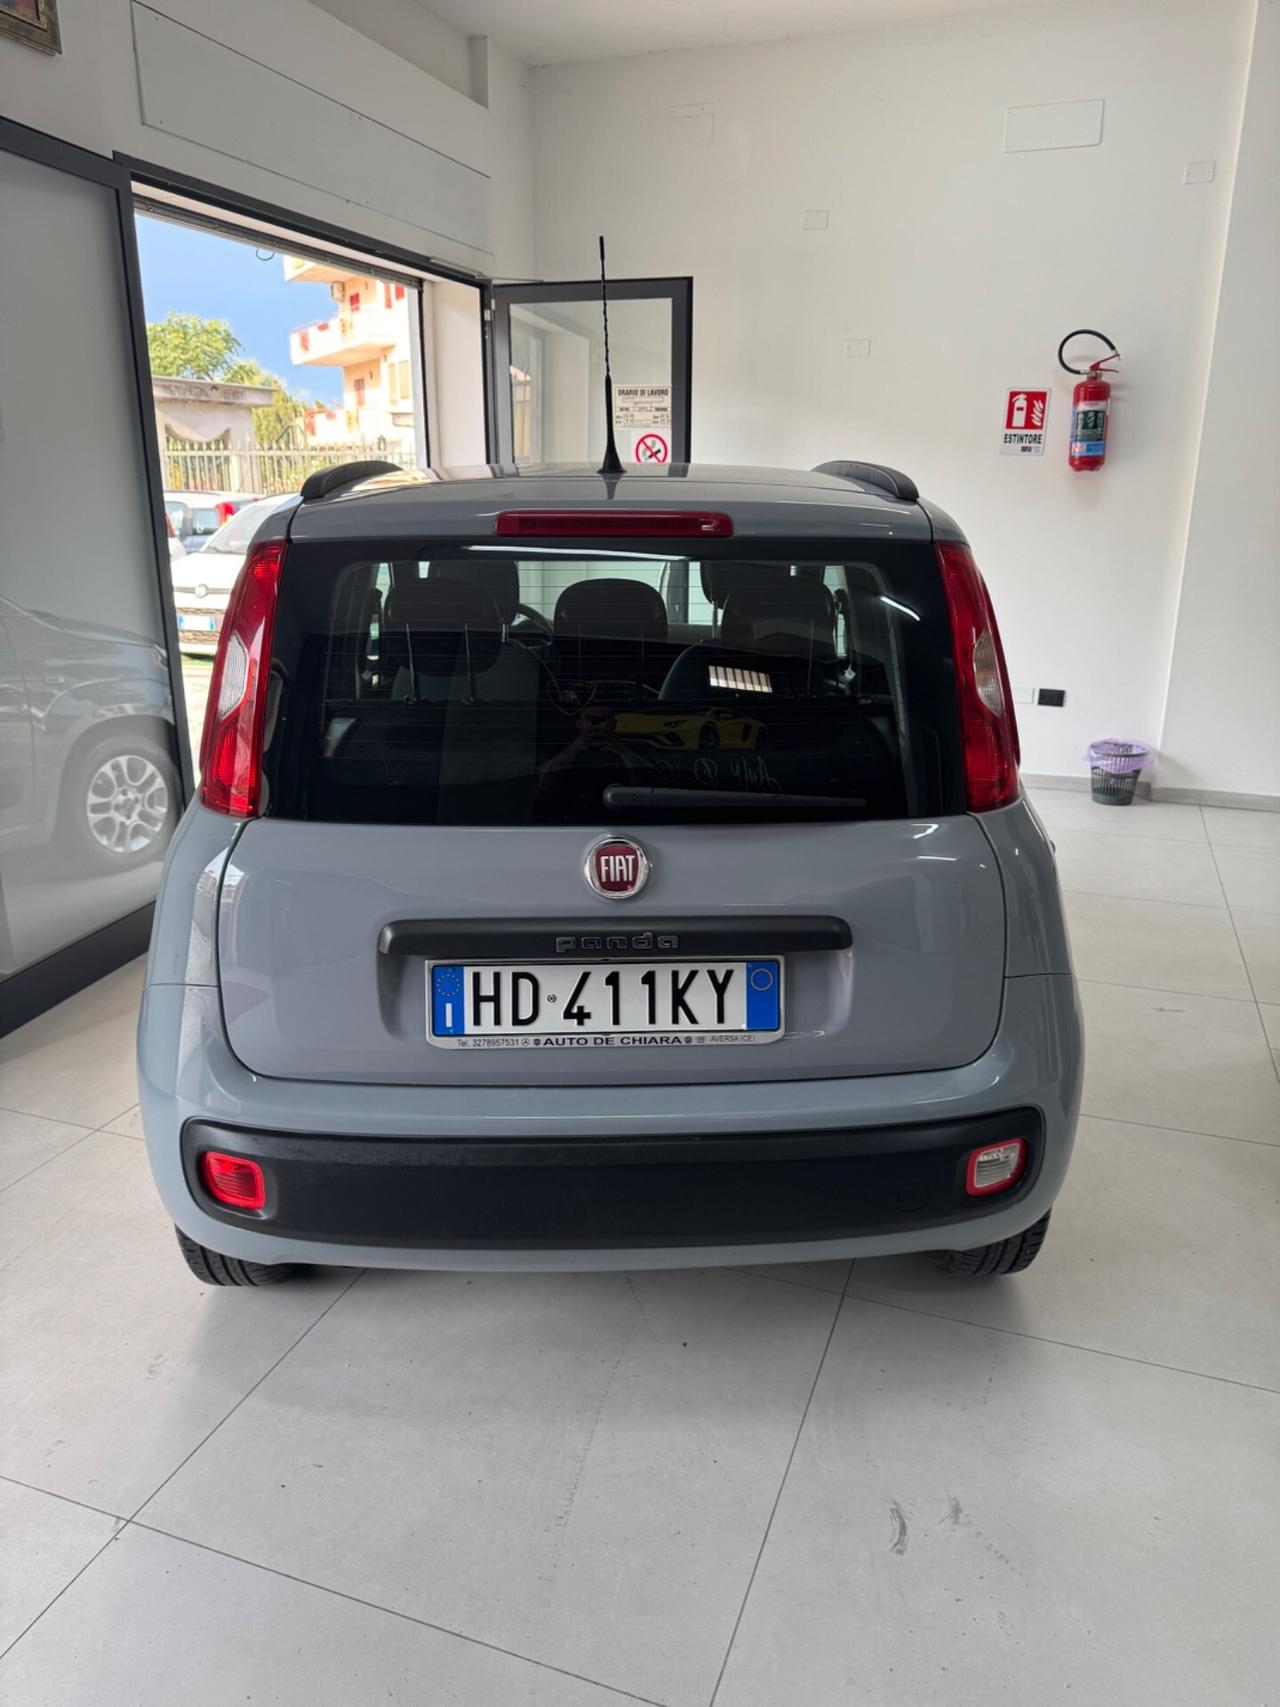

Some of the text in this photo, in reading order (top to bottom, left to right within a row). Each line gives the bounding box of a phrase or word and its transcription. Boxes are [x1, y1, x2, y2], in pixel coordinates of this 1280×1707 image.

[1004, 434, 1042, 444] ESTINTORE
[600, 854, 635, 882] FIAT
[472, 968, 735, 1027] HD 411KY
[543, 1037, 588, 1047] AUTO
[594, 1036, 616, 1046] DE
[620, 1036, 682, 1045] CHIARA
[710, 1034, 740, 1043] AVERSA
